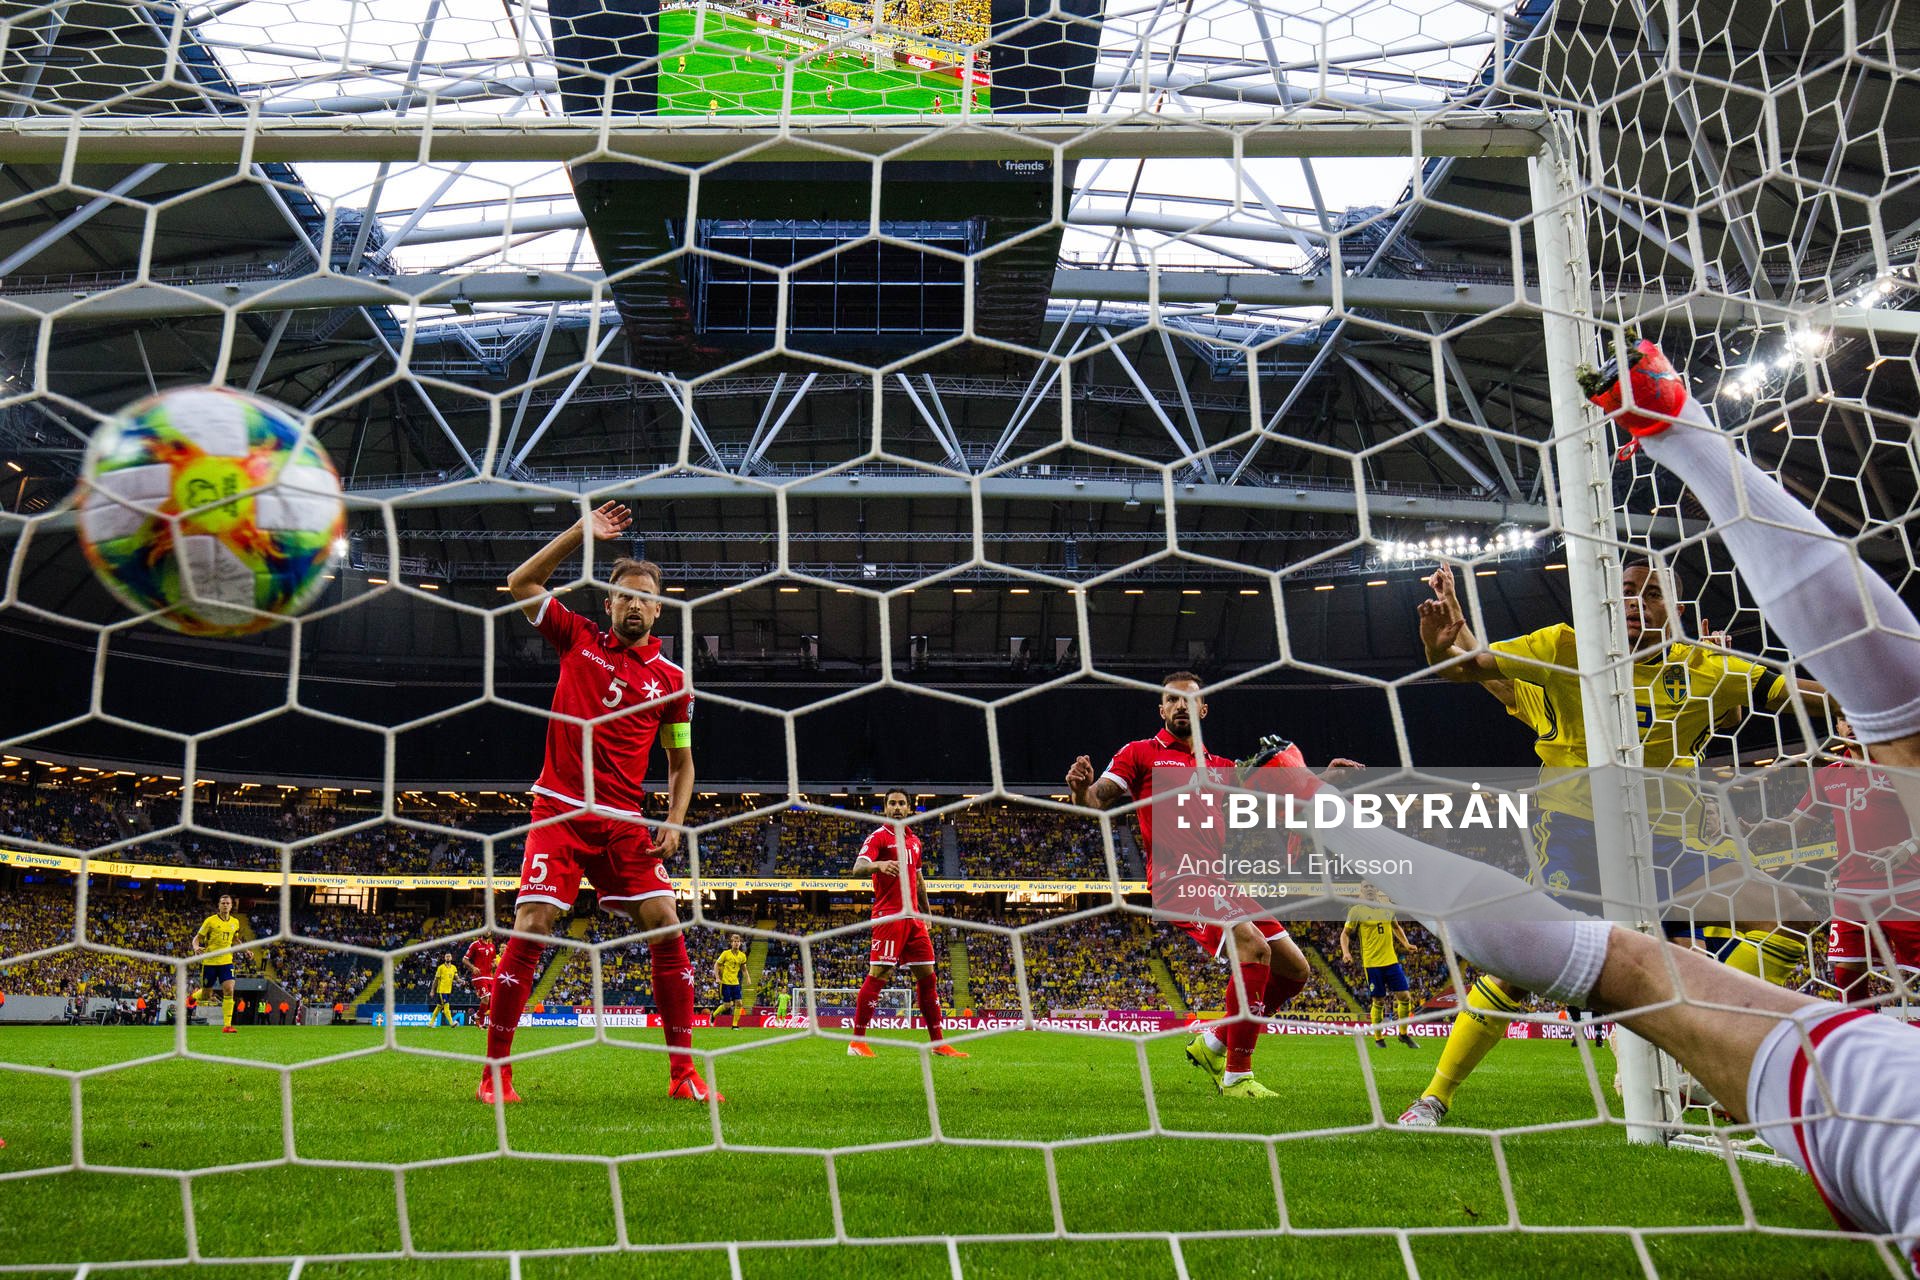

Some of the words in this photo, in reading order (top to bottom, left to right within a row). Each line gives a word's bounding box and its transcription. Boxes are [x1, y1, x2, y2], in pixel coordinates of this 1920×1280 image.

[1005, 160, 1045, 171] friends
[582, 649, 615, 671] GIVOVA
[602, 677, 628, 708] 5
[1845, 787, 1867, 811] 15
[109, 865, 135, 874] 01:17
[529, 853, 549, 884] 5
[1213, 891, 1233, 912] 4
[1377, 922, 1385, 935] 6
[884, 940, 895, 957] 11
[580, 1016, 643, 1026] CAALIERE
